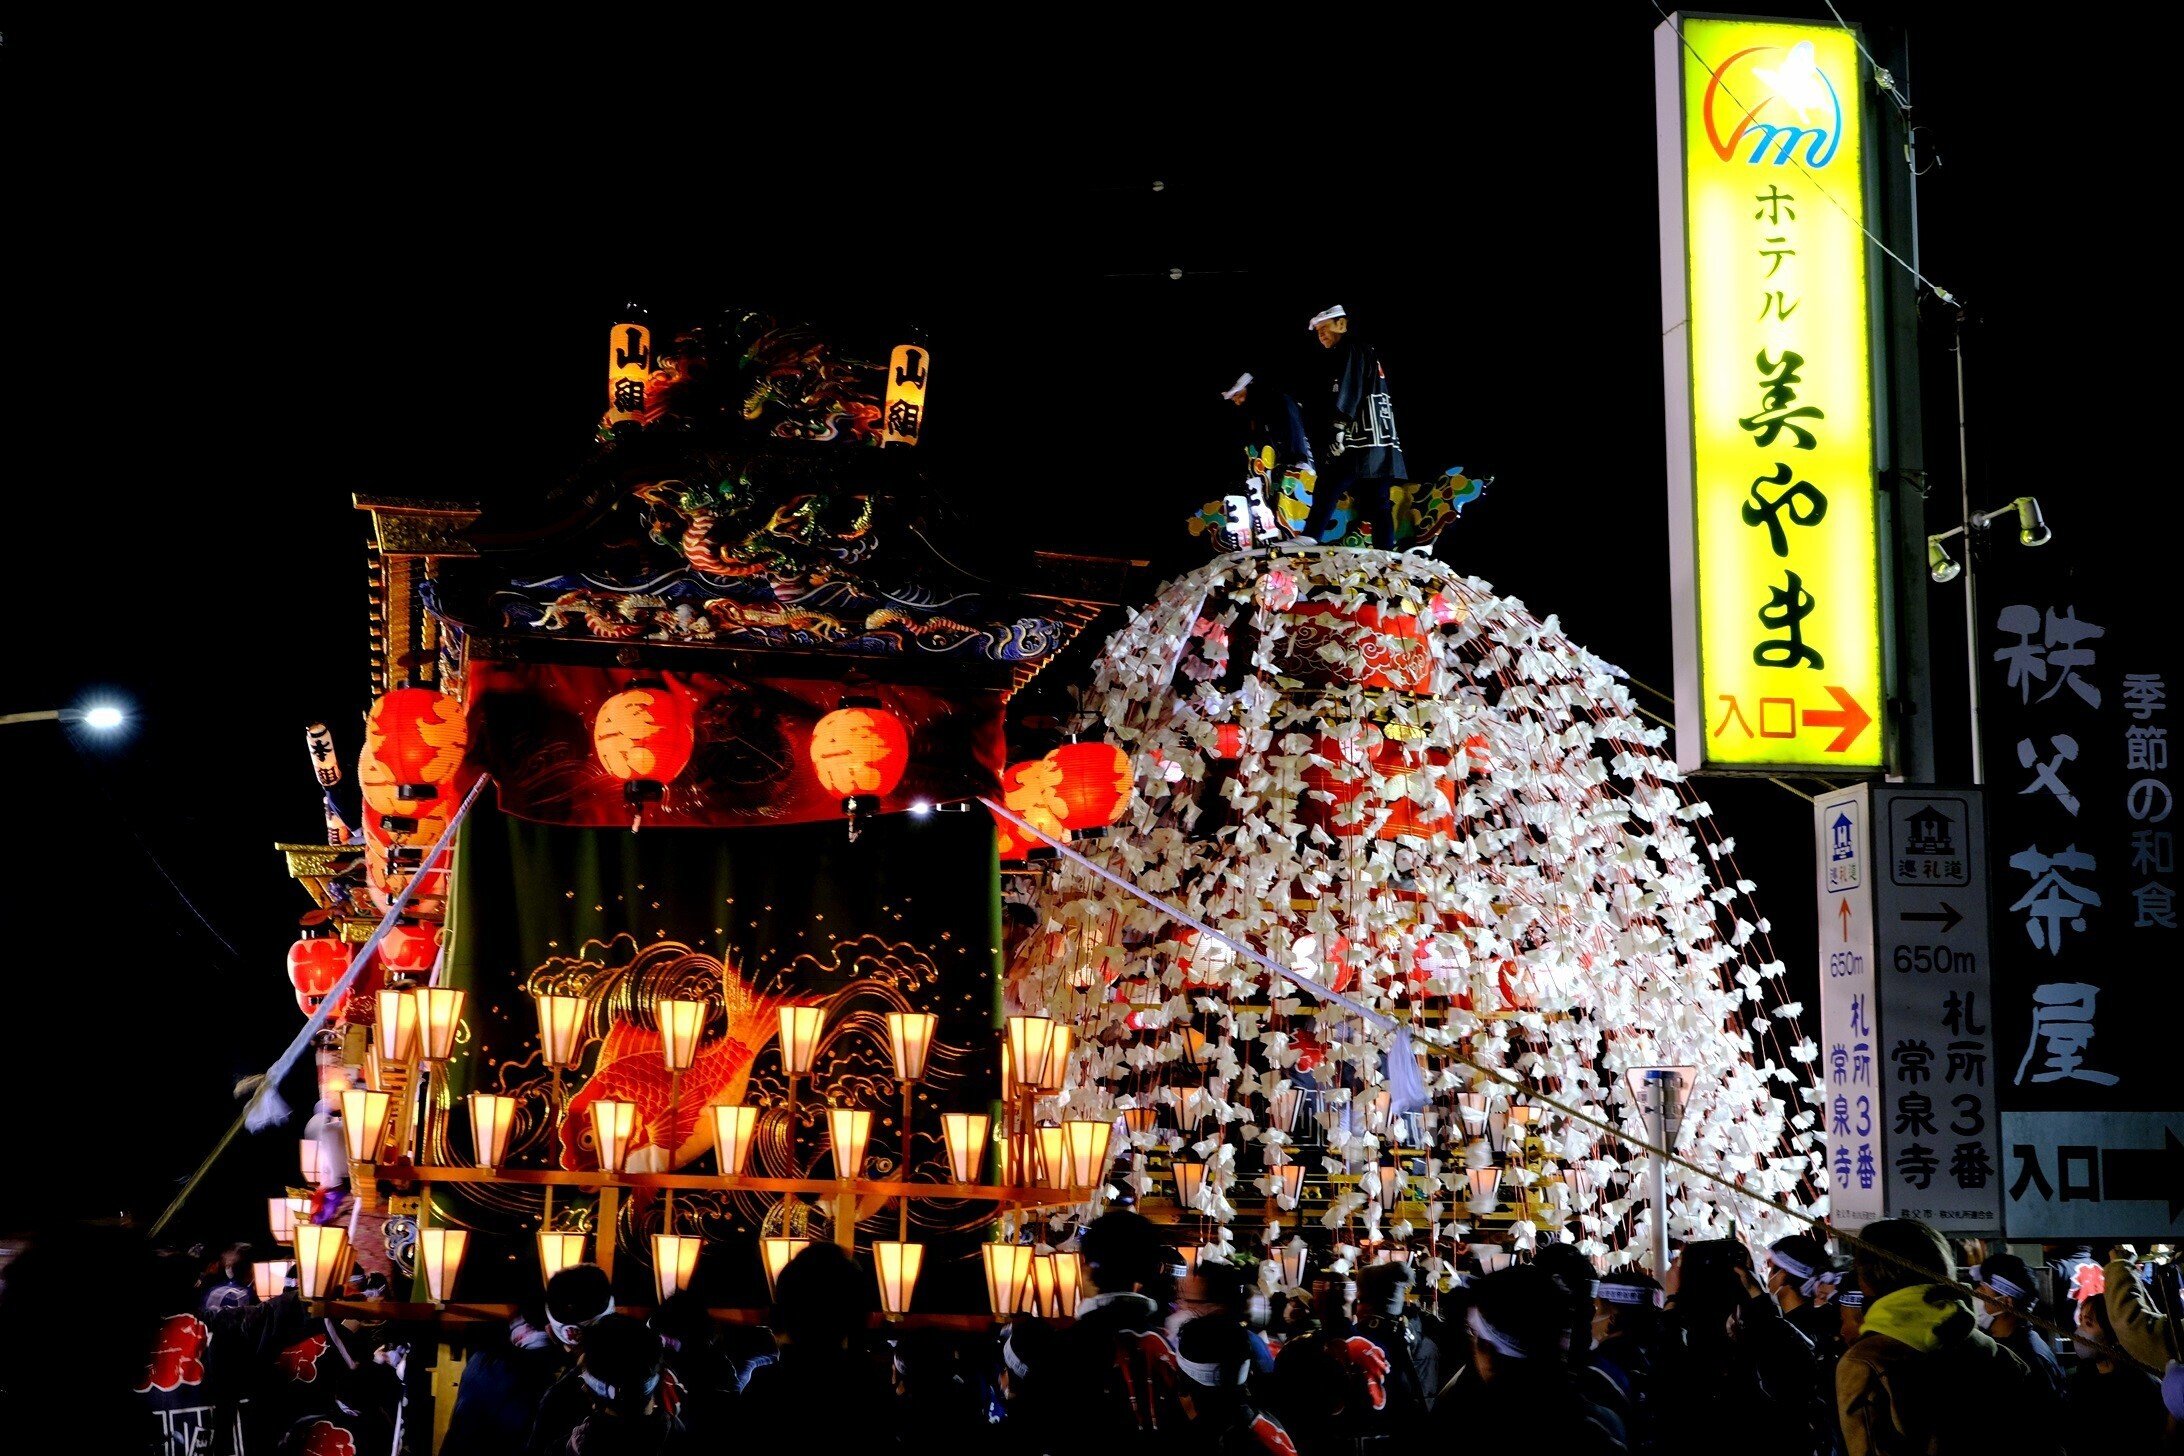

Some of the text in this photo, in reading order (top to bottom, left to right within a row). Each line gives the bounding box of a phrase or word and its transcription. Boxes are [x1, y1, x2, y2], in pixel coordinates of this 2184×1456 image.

[614, 327, 649, 415] 山組
[888, 348, 925, 438] 山組
[1739, 184, 1828, 671] ホテル 美やま
[1714, 694, 1796, 739] 入口
[1994, 604, 2121, 1086] 秩父茶屋
[2123, 673, 2178, 929] 季節の和食
[1899, 859, 1963, 880] 巡礼道
[1830, 950, 1864, 978] 650m
[1894, 944, 1976, 974] 650m
[1830, 1043, 1852, 1190] 常泉寺
[1891, 1039, 1939, 1190] 常泉寺
[2009, 1144, 2100, 1202] 入口
